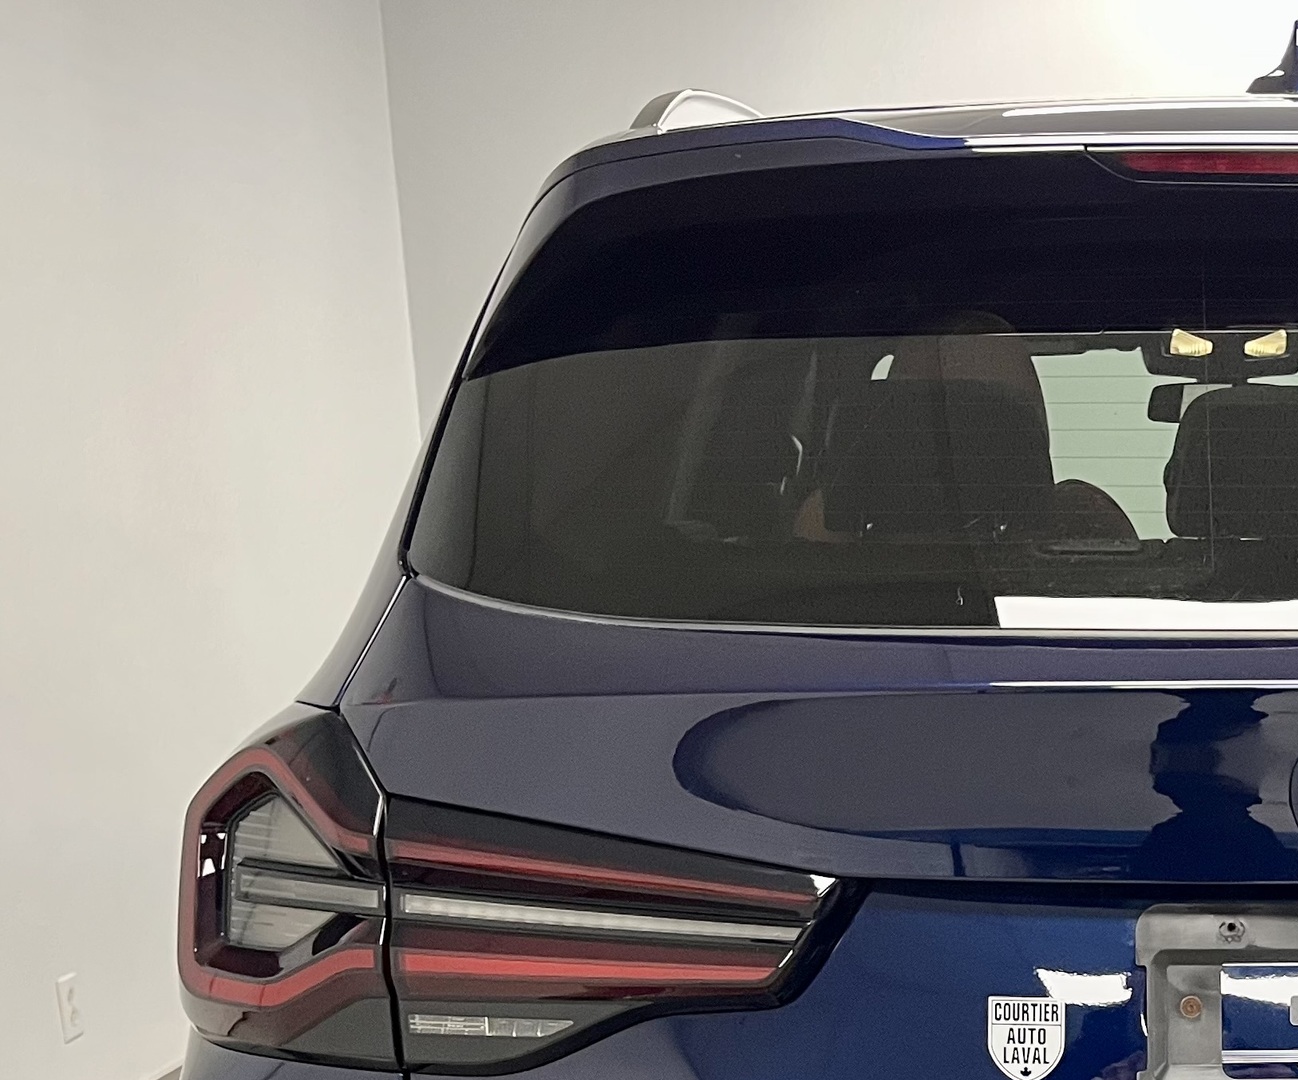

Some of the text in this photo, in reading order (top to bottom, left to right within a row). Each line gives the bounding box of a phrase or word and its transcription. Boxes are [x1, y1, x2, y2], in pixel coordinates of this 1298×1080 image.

[994, 1002, 1059, 1022] COURTIER
[1007, 1027, 1046, 1045] AUTO
[1003, 1046, 1050, 1064] LAVAL
